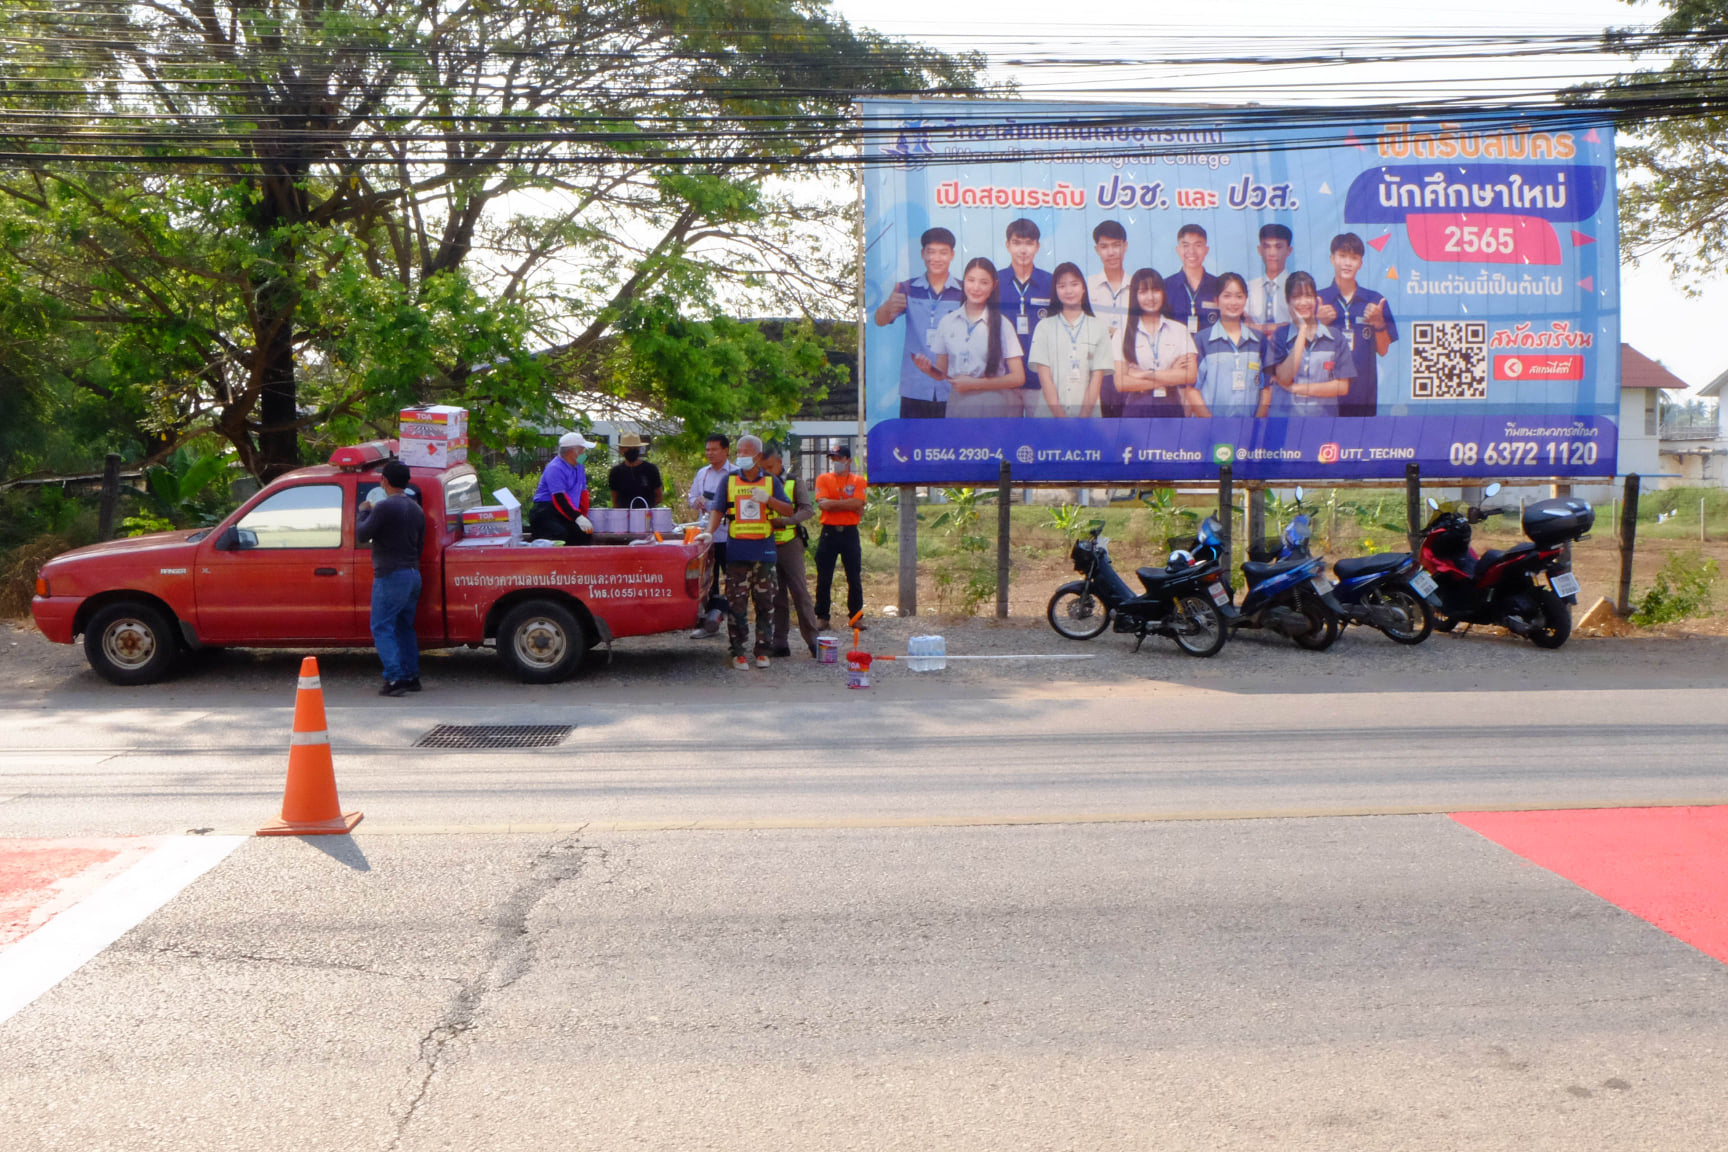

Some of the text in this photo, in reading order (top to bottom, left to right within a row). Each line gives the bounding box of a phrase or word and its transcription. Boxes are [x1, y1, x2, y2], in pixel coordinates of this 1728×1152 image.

[1377, 122, 1576, 159] เปิดรับสมัคร
[1163, 147, 1231, 169] College
[936, 175, 1298, 208] เปิดสอนระดับ ปวช. และ ปวส.
[1379, 171, 1567, 208] นักศึกษาใหม่
[1444, 226, 1514, 254] 2565
[1407, 270, 1563, 295] ตั้งแต่วันนี้เป็นต้นไป
[1490, 321, 1593, 349] สมัครเรียน
[913, 448, 1003, 461] 0 5544 2930-4
[1037, 450, 1101, 461] UTT.AC.TH
[1138, 448, 1202, 461] UTTtechno
[1340, 447, 1414, 461] UTT_TECHNO
[1450, 442, 1598, 465] 08 6372 1120
